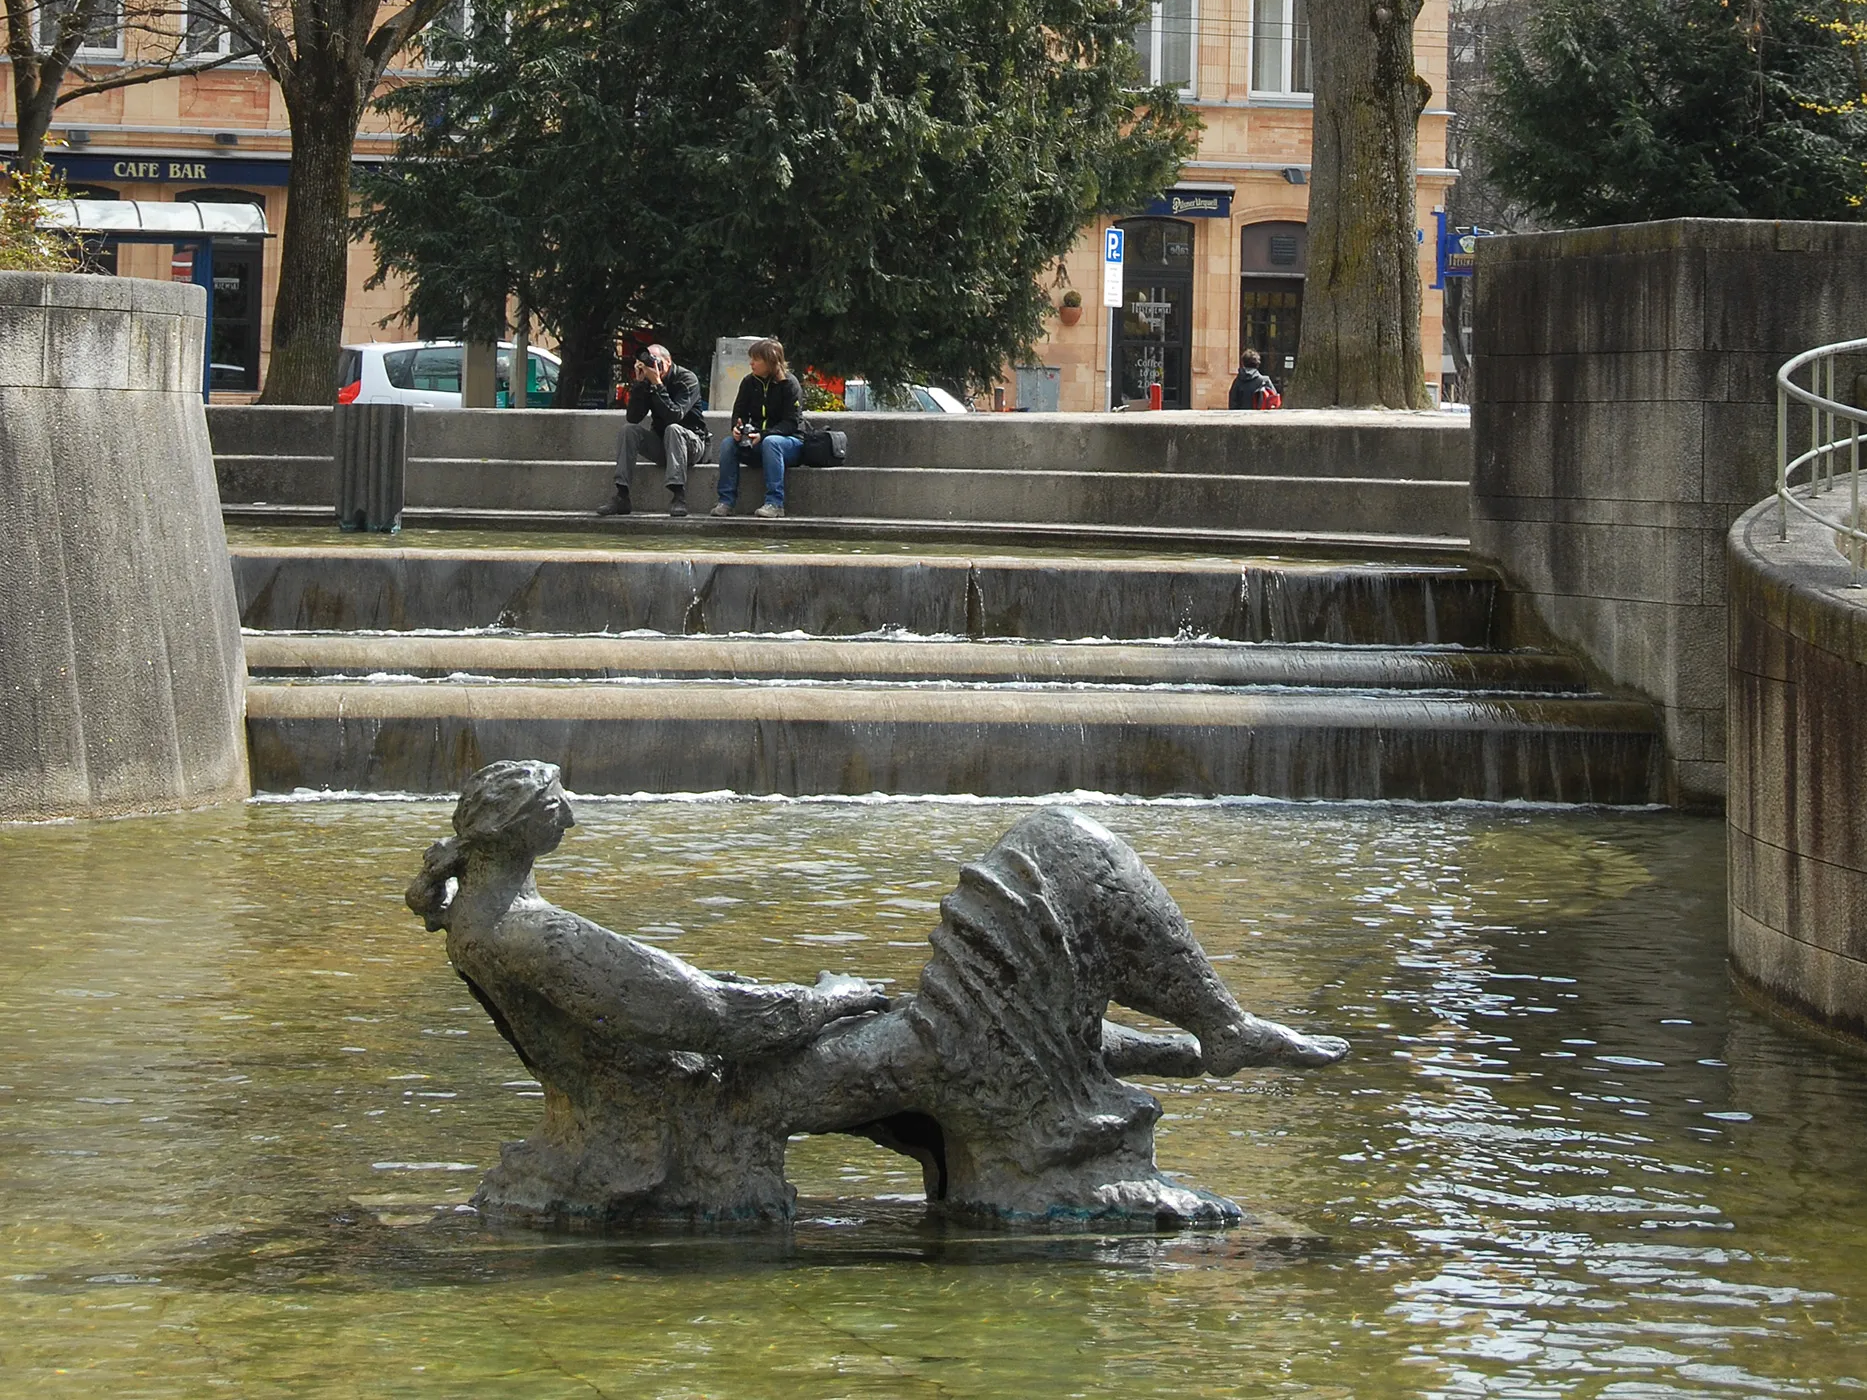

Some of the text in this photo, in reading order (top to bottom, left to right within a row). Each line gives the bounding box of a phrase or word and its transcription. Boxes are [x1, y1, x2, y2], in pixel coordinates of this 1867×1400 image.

[114, 161, 206, 179] CAFE BAR
[1107, 233, 1119, 259] P
[1137, 358, 1163, 368] Coffee
[1139, 368, 1160, 380] to go
